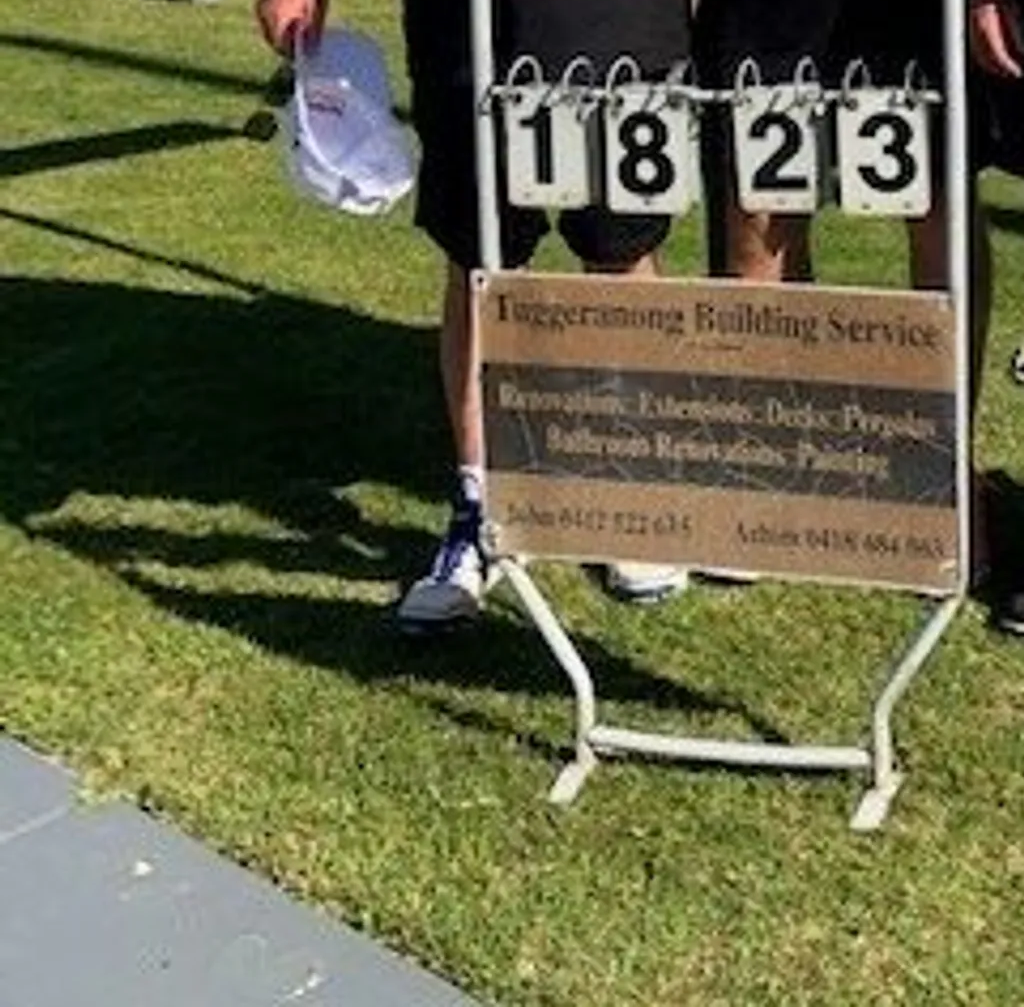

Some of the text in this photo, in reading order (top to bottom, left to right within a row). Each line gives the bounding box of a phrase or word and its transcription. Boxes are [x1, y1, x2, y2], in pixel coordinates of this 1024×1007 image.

[498, 294, 941, 348] Tuggeranong Building Service
